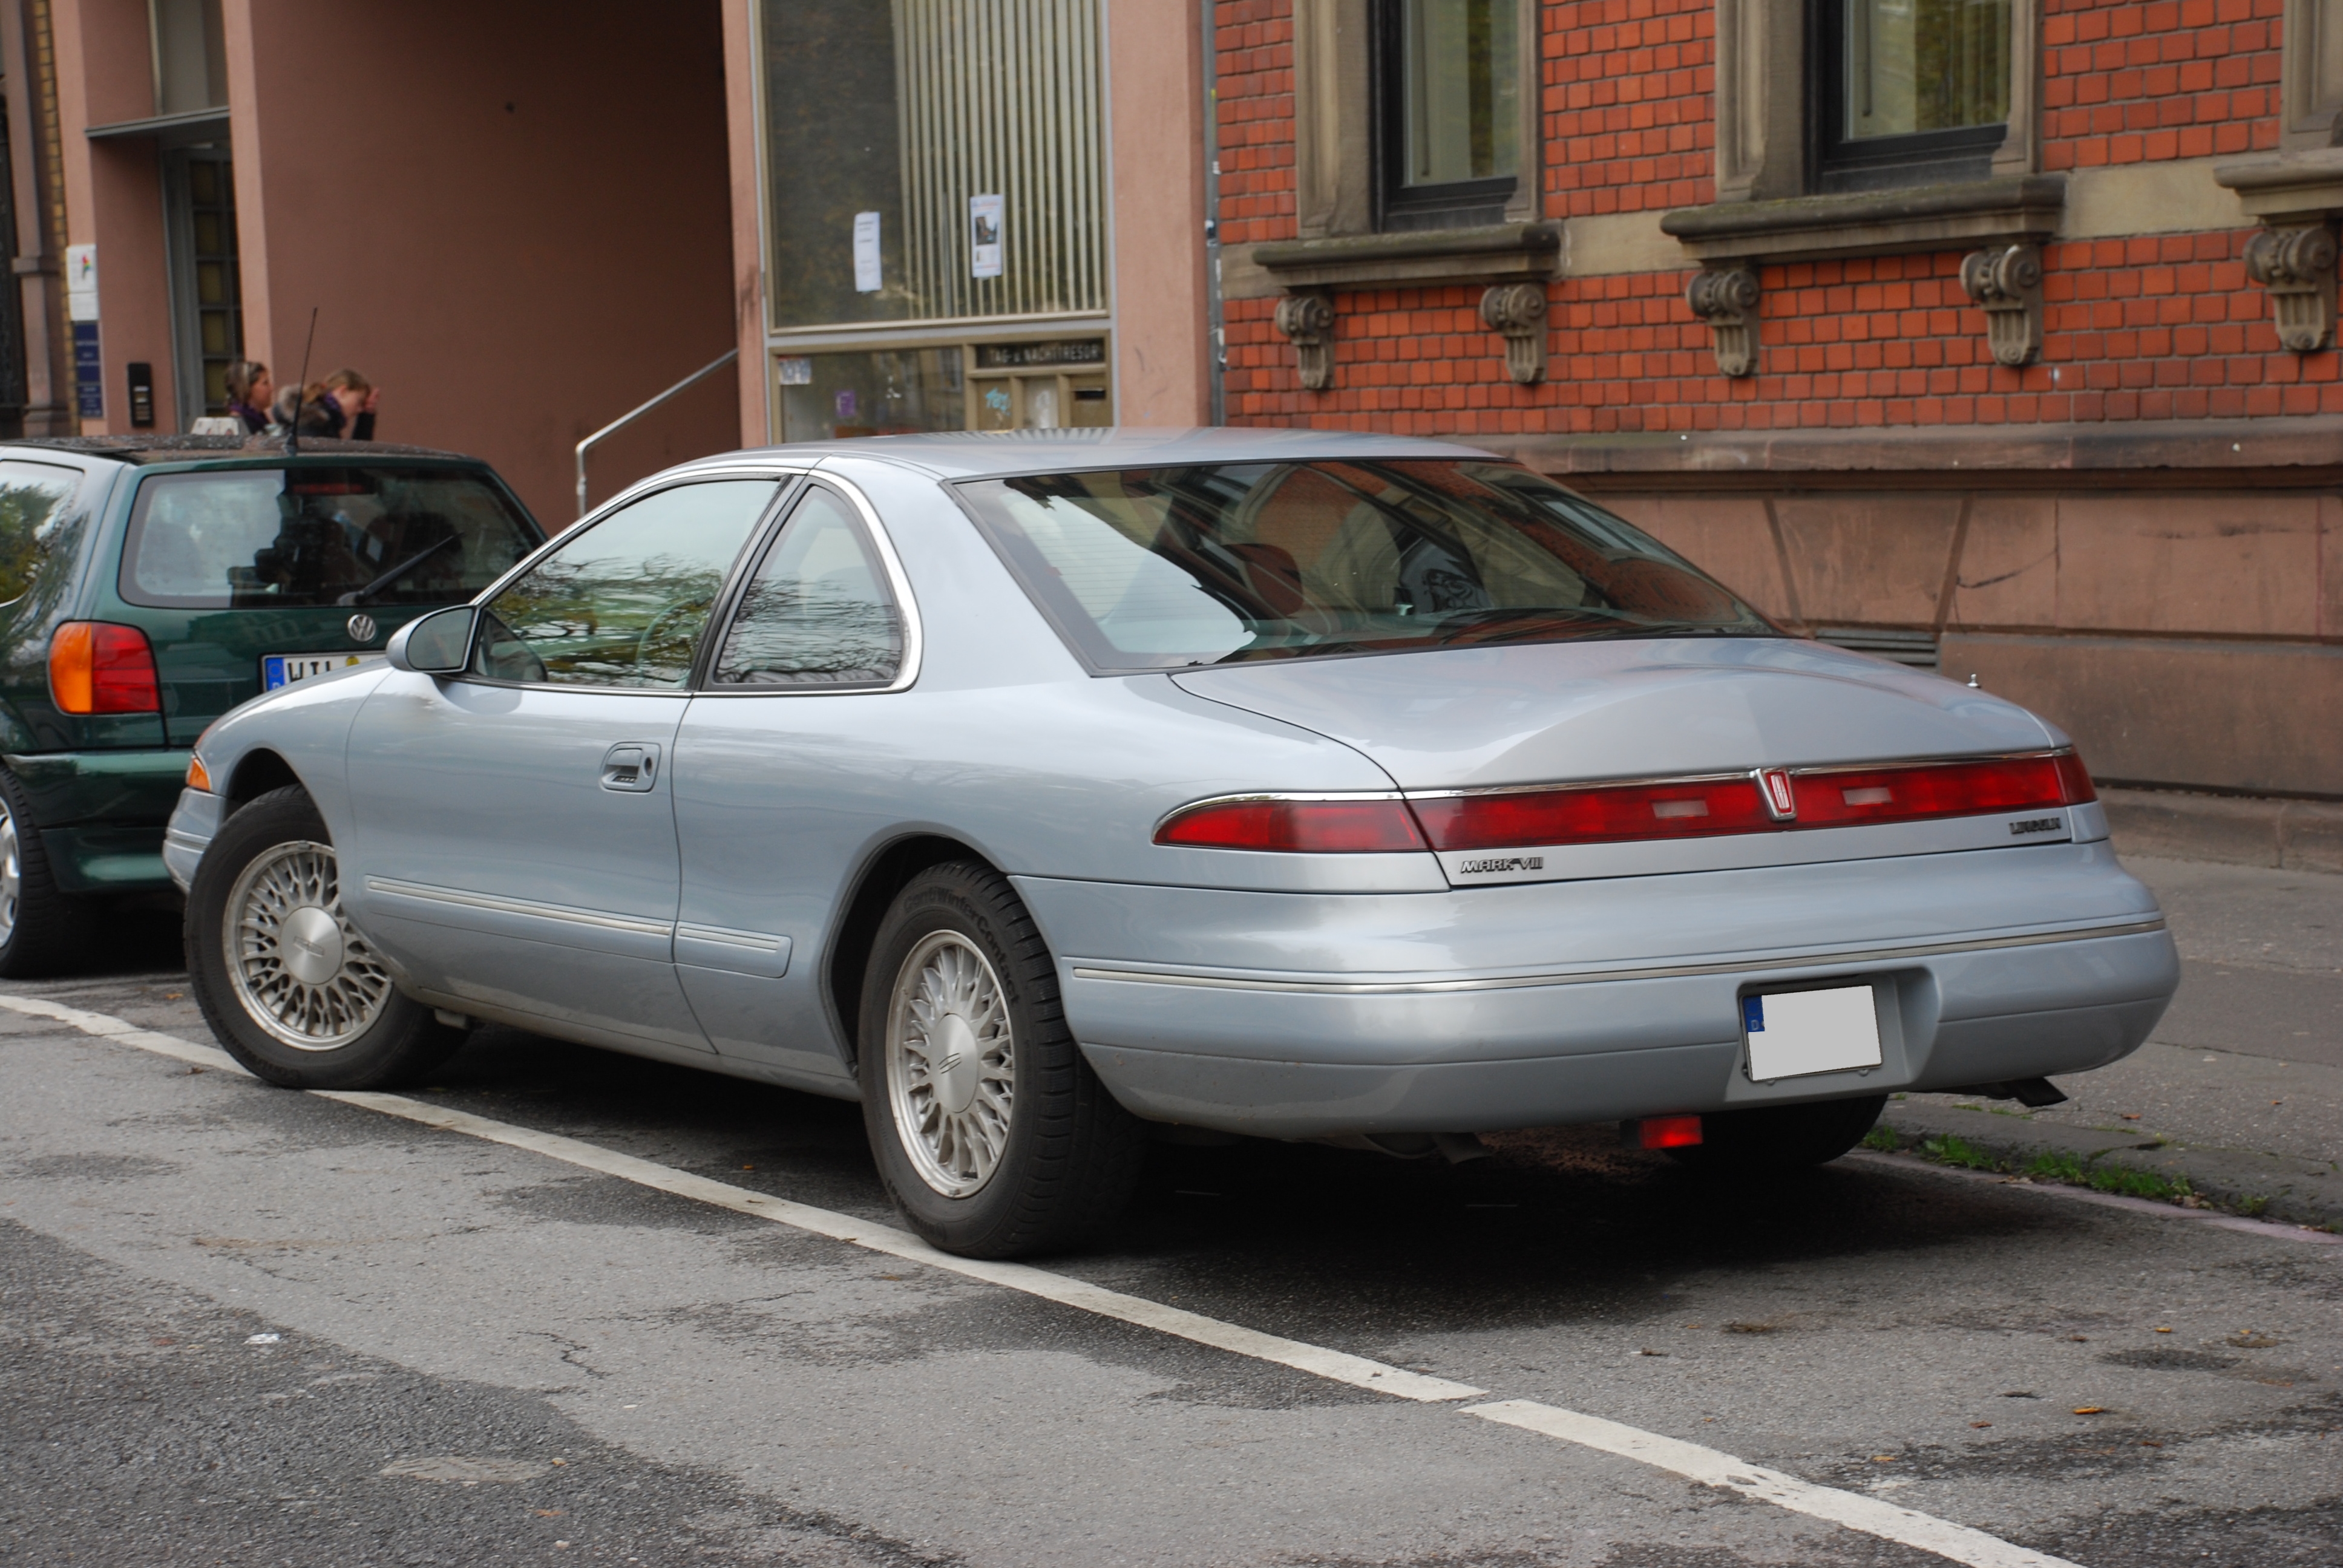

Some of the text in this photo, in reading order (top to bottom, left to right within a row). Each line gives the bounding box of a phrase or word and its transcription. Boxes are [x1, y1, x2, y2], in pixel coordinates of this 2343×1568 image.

[1461, 857, 1544, 874] MARK VIII
[1750, 1019, 1760, 1031] D
